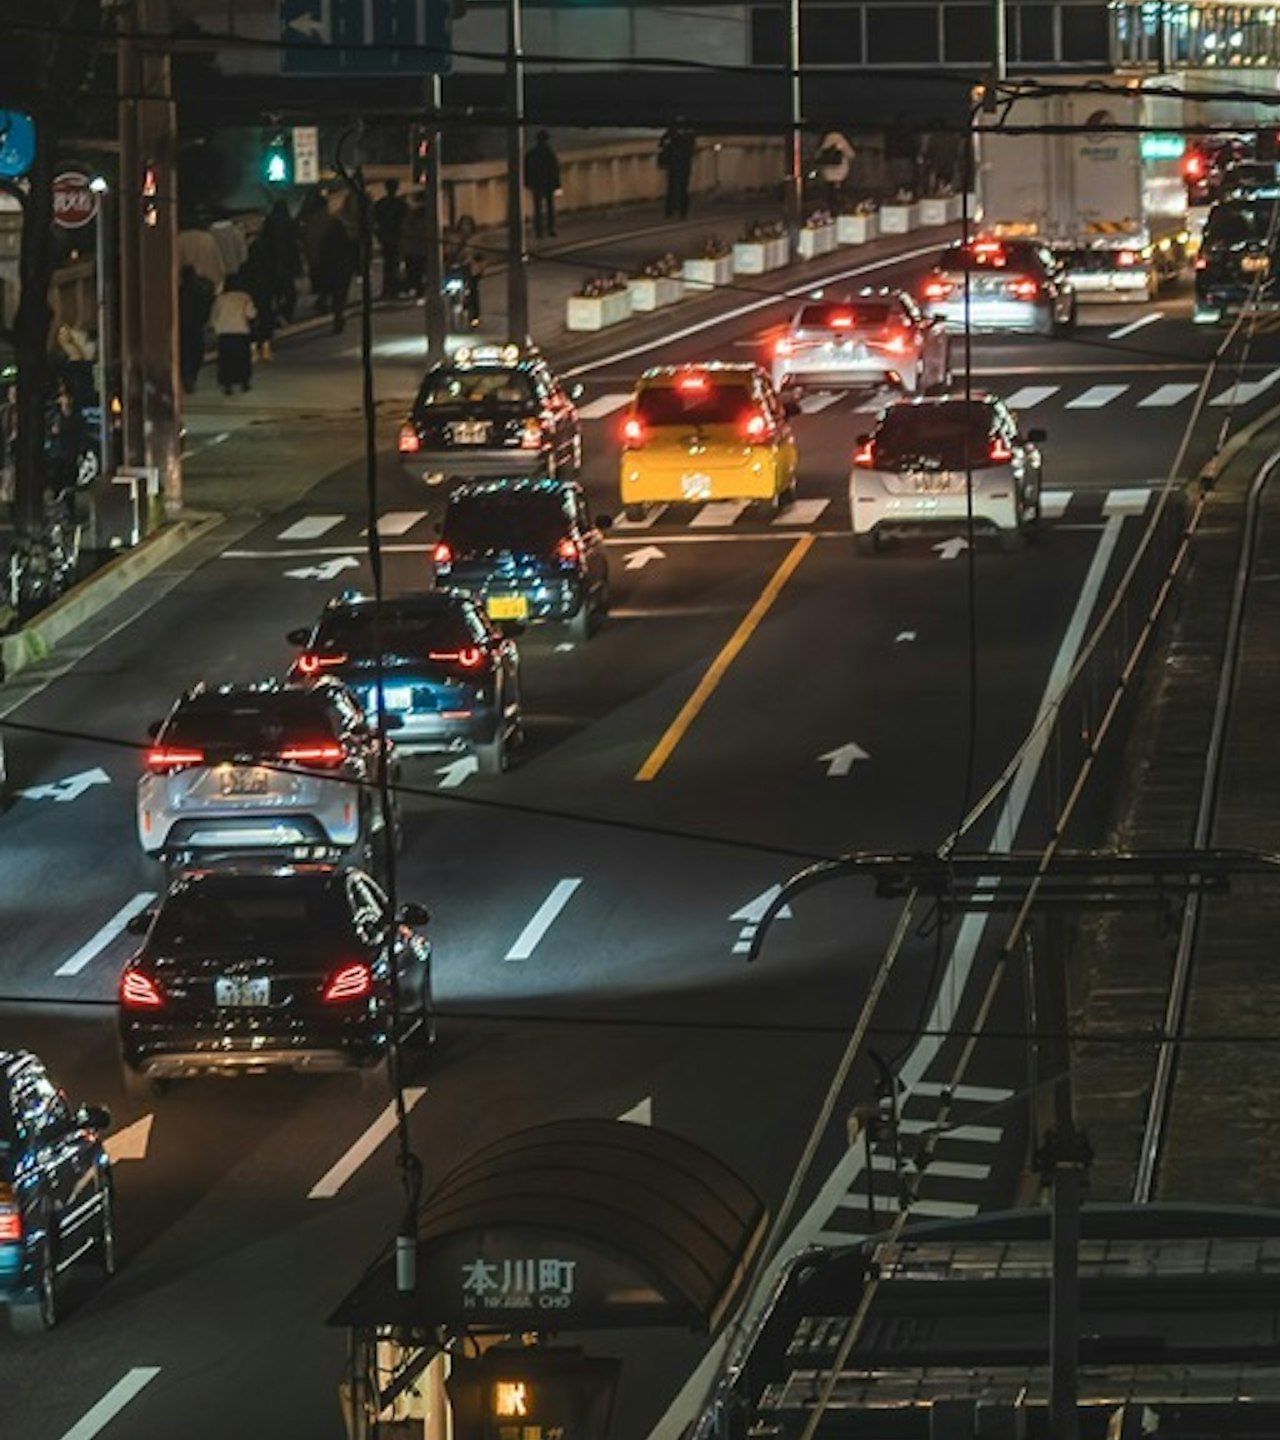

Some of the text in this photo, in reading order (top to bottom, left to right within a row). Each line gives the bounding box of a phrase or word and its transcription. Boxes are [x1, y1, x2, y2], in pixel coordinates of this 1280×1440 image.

[460, 1258, 577, 1296] 本川町
[538, 1294, 572, 1309] CHO
